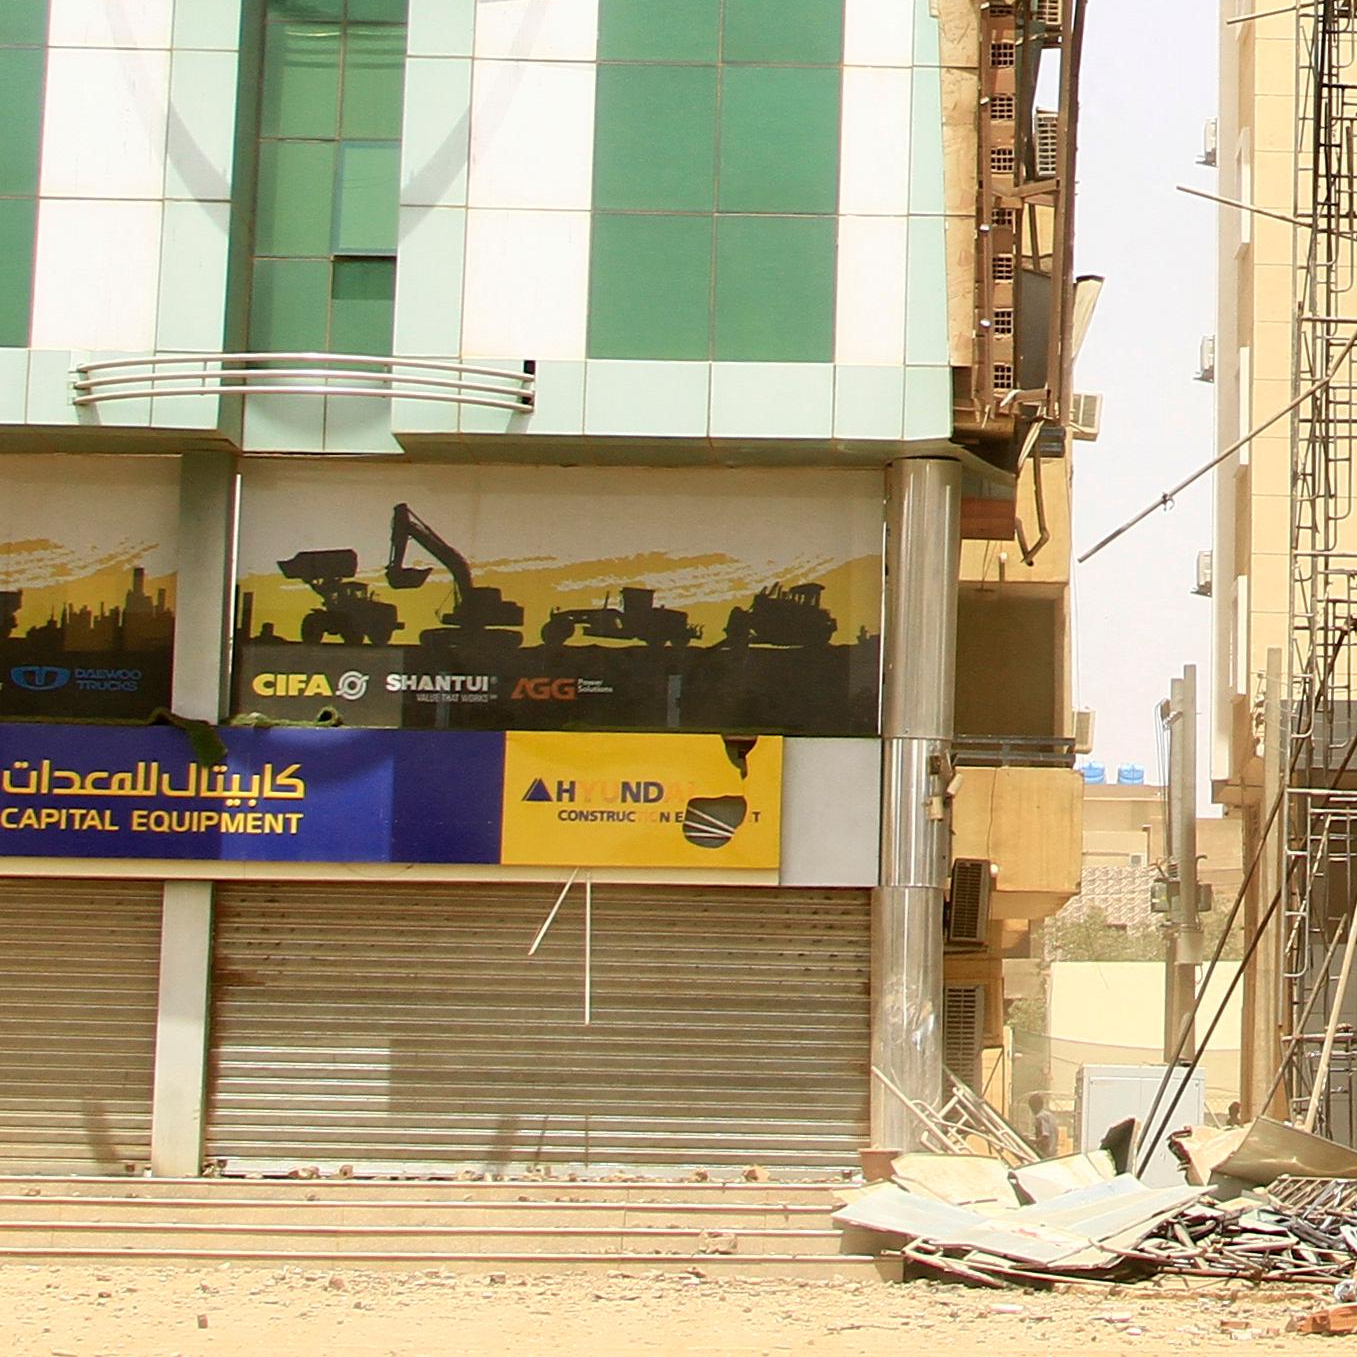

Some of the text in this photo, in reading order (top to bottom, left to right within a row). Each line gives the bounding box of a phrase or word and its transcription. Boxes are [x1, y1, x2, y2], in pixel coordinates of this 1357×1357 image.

[74, 668, 142, 680] DAEWOO
[252, 672, 333, 697] CIFA
[385, 673, 489, 692] SHANTUI
[75, 680, 138, 692] TRUCKS
[511, 677, 577, 700] AGG
[2, 759, 159, 797] للمعدات
[1, 807, 304, 834] CAPITAL EQUIPMENT
